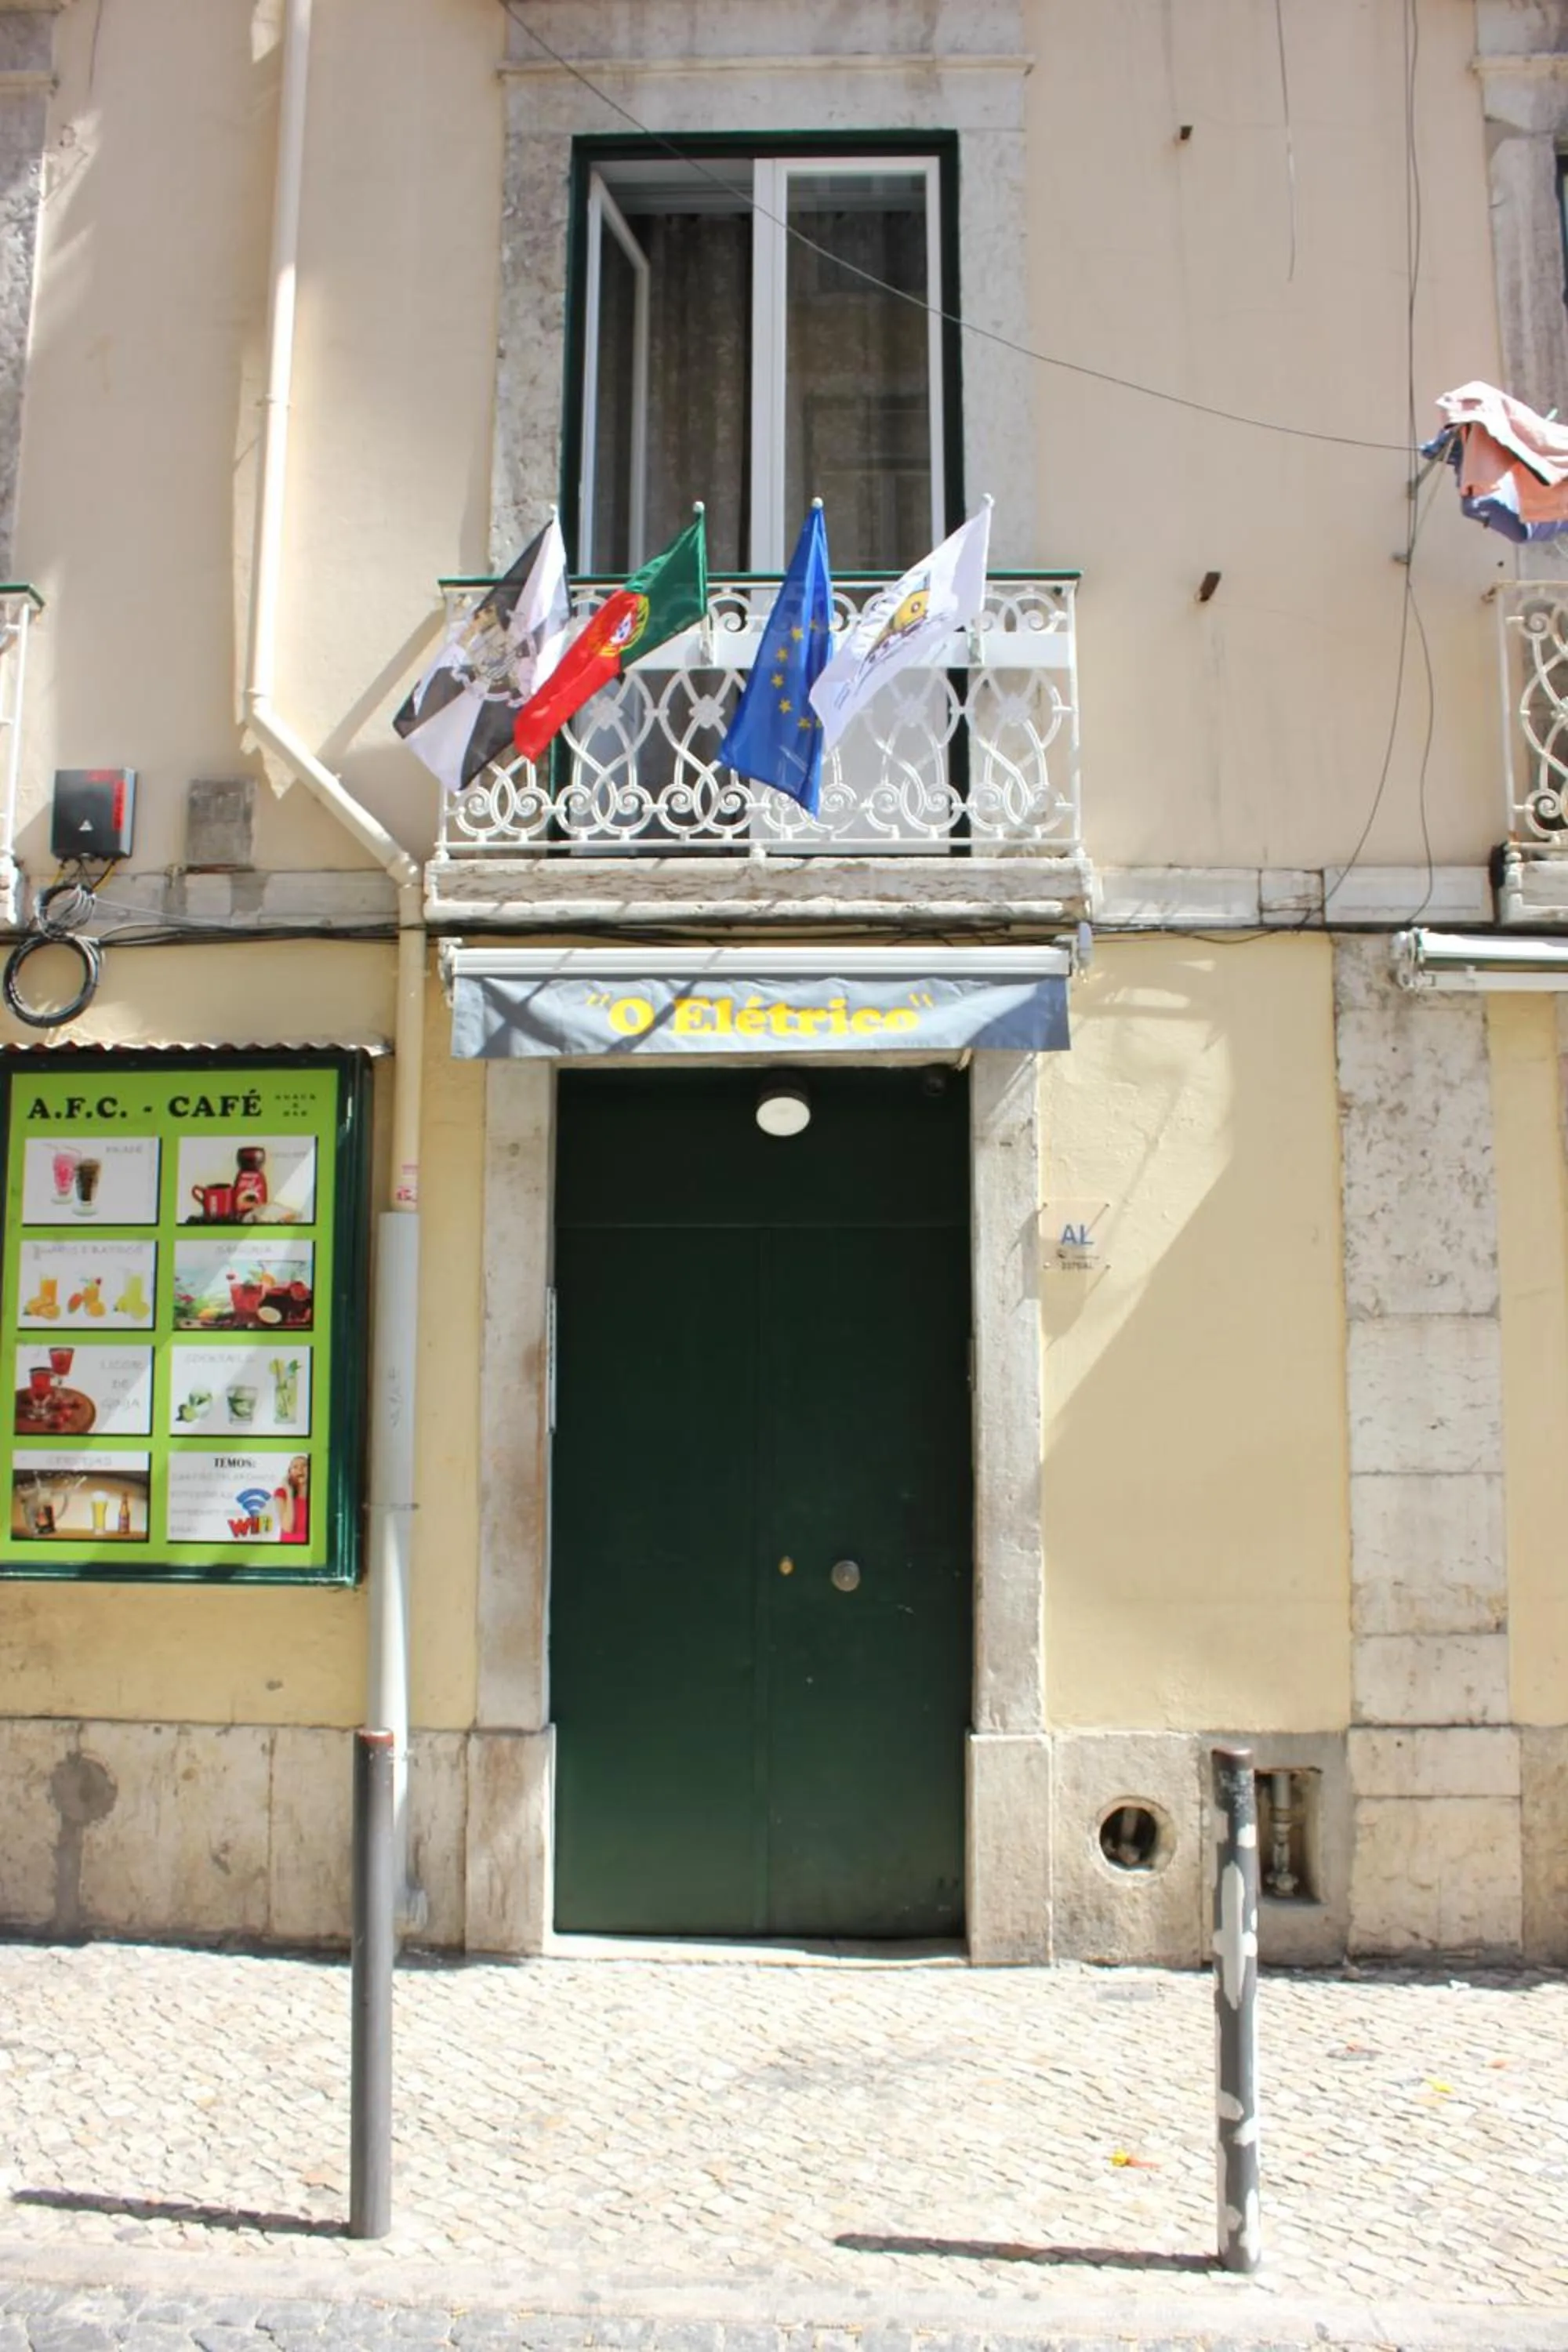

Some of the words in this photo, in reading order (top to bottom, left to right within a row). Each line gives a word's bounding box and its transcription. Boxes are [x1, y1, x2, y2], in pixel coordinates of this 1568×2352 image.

[27, 1096, 128, 1120] A.F.C.
[168, 1088, 263, 1118] CAFÉ
[1060, 1224, 1094, 1246] AL
